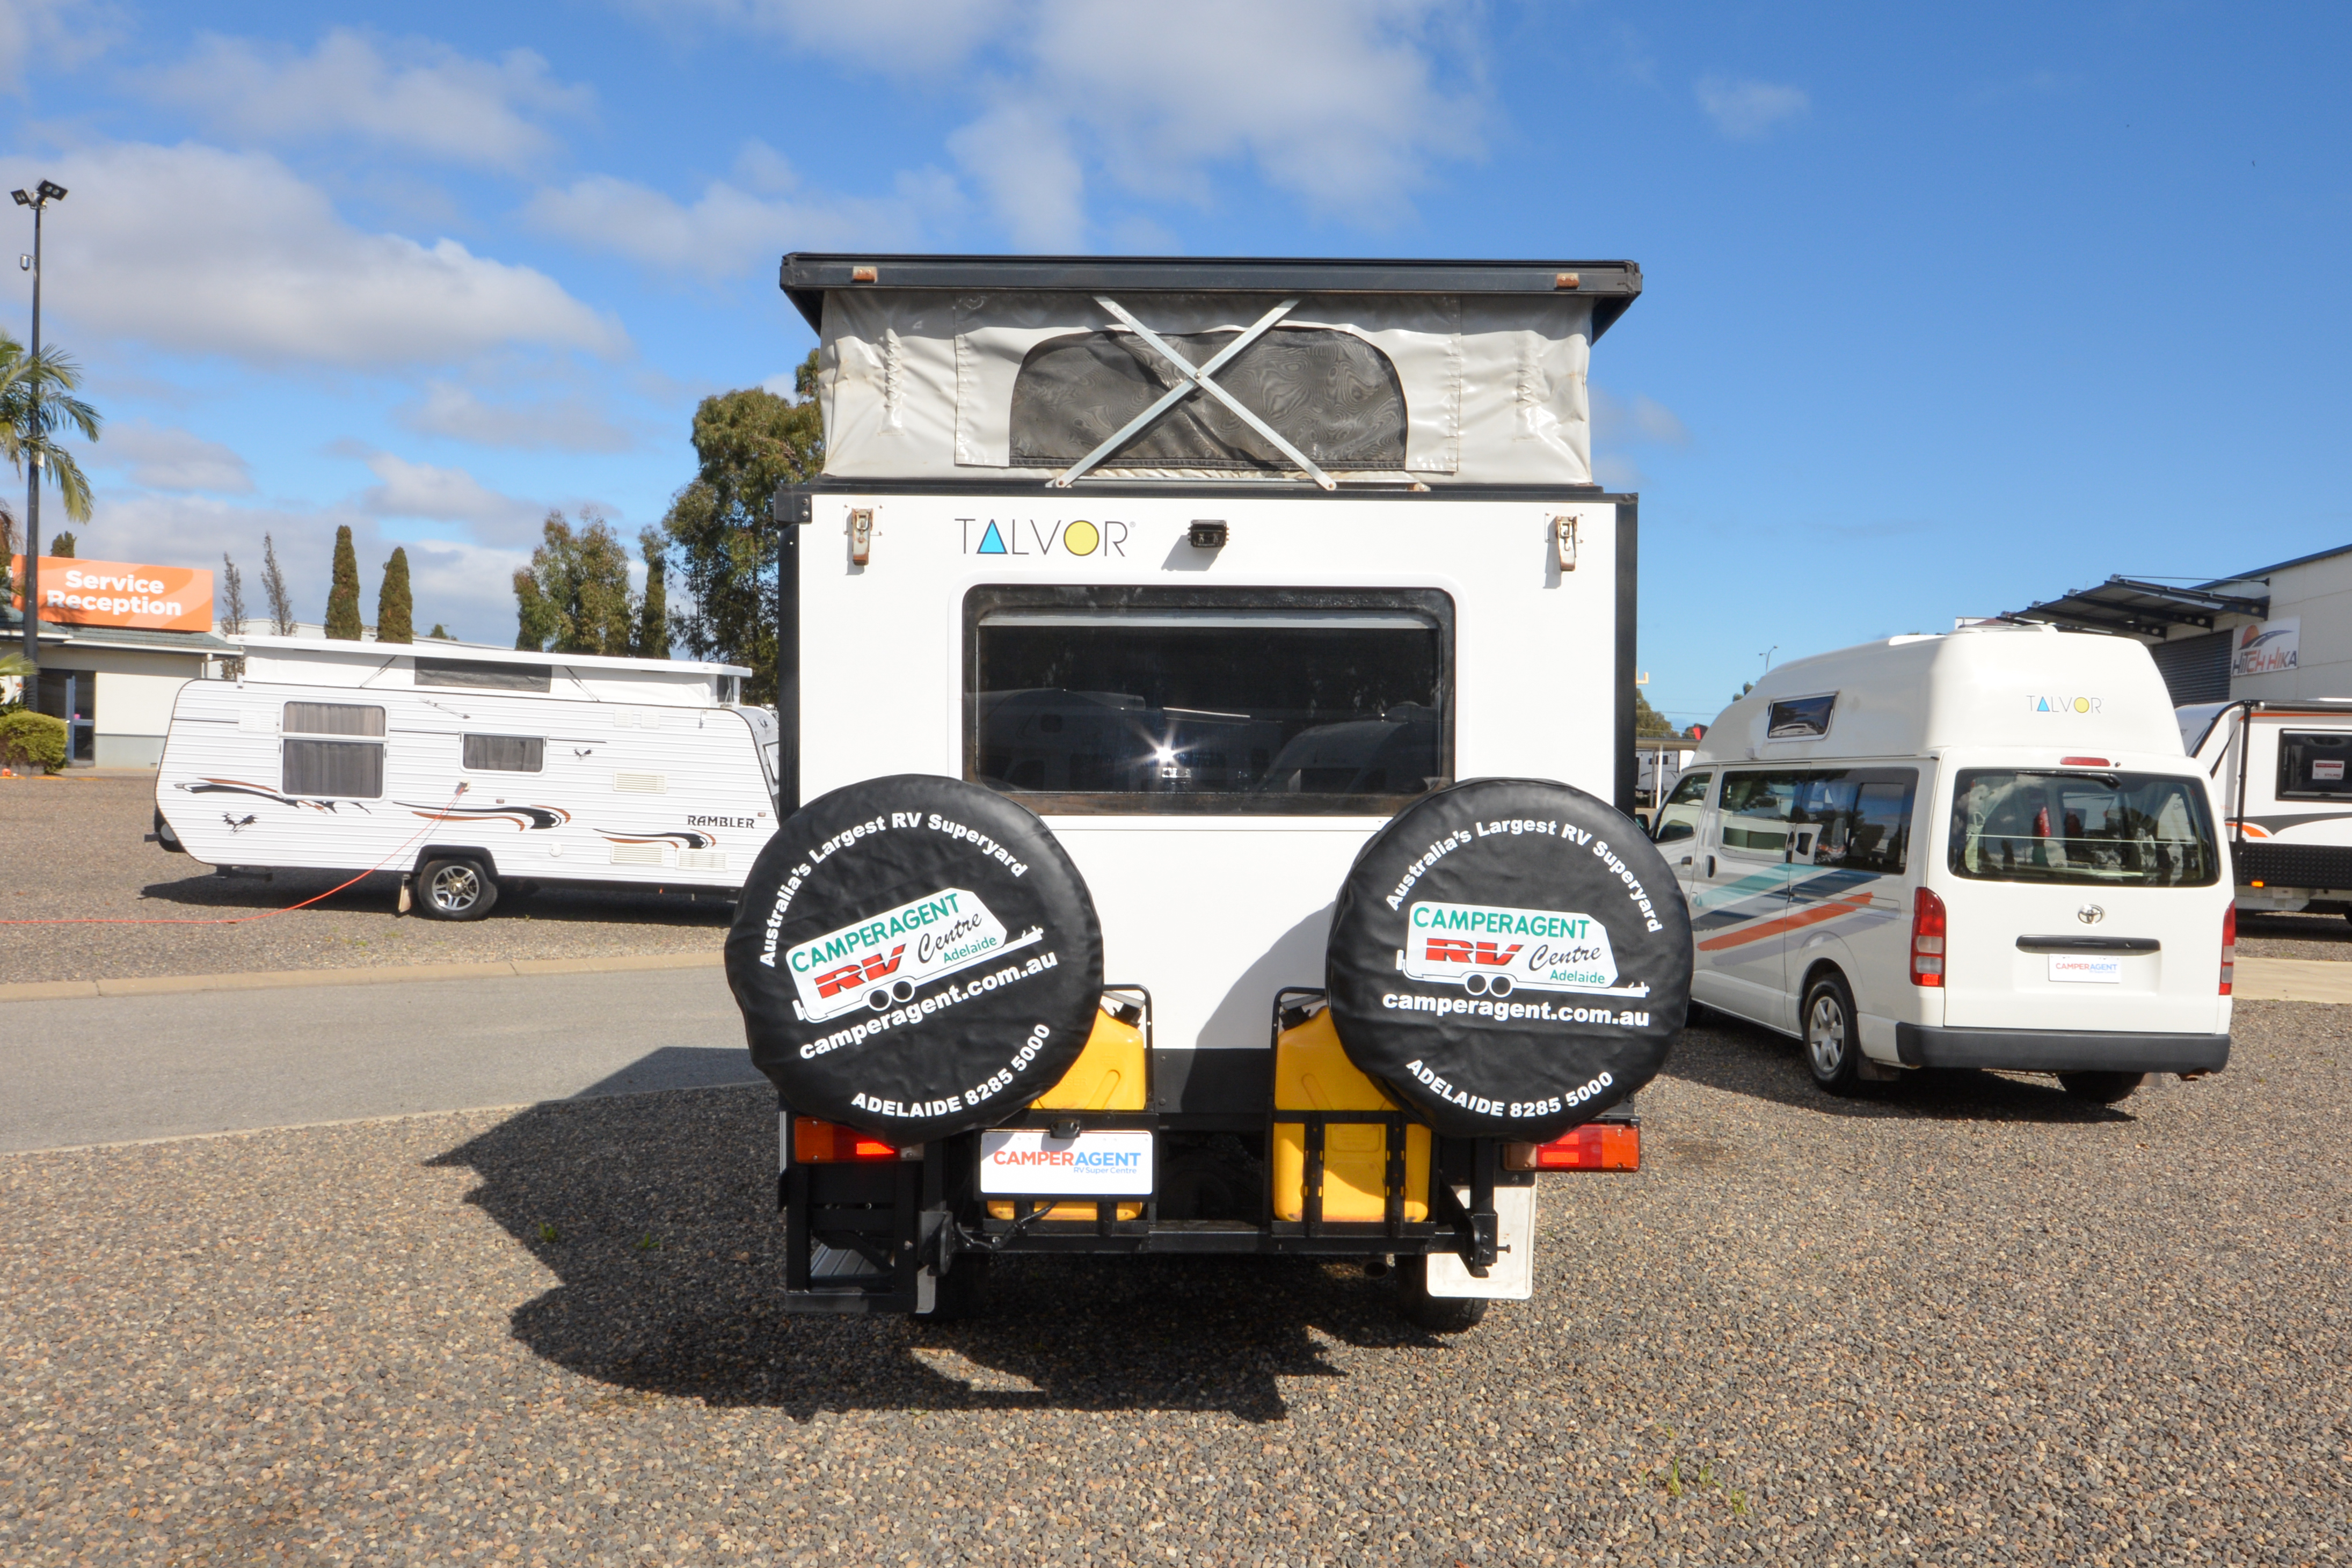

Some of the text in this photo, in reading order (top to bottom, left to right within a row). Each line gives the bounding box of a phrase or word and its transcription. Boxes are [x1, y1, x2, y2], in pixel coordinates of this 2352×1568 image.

[954, 518, 1128, 557] TALVOR
[65, 570, 165, 594] Service
[46, 589, 182, 616] Reception
[2232, 646, 2297, 674] HITCH HIKA
[2026, 695, 2102, 714] TALVOR
[687, 815, 755, 829] RAMBLER
[759, 811, 1029, 968] Australia's Largest RV Superyard
[1385, 819, 1663, 933] Australia's Largest RV Superyard
[791, 893, 959, 972] CAMPERAGENT
[1413, 907, 1590, 940] CAMPERAGENT
[814, 914, 982, 999] RV Centre
[944, 936, 997, 964] Adelaide
[1425, 938, 1601, 971] RV Centre
[2056, 962, 2117, 971] CAMPERAGENT
[1549, 969, 1605, 984] Adelaide
[799, 951, 1059, 1060] camperagent.com.au
[1382, 993, 1650, 1027] camperagent.com.au
[850, 1024, 1051, 1118] ADELAIDE 8285 5000
[1406, 1059, 1613, 1118] ADELAIDE 8285 5000
[993, 1150, 1141, 1166] CAMPERAGENT
